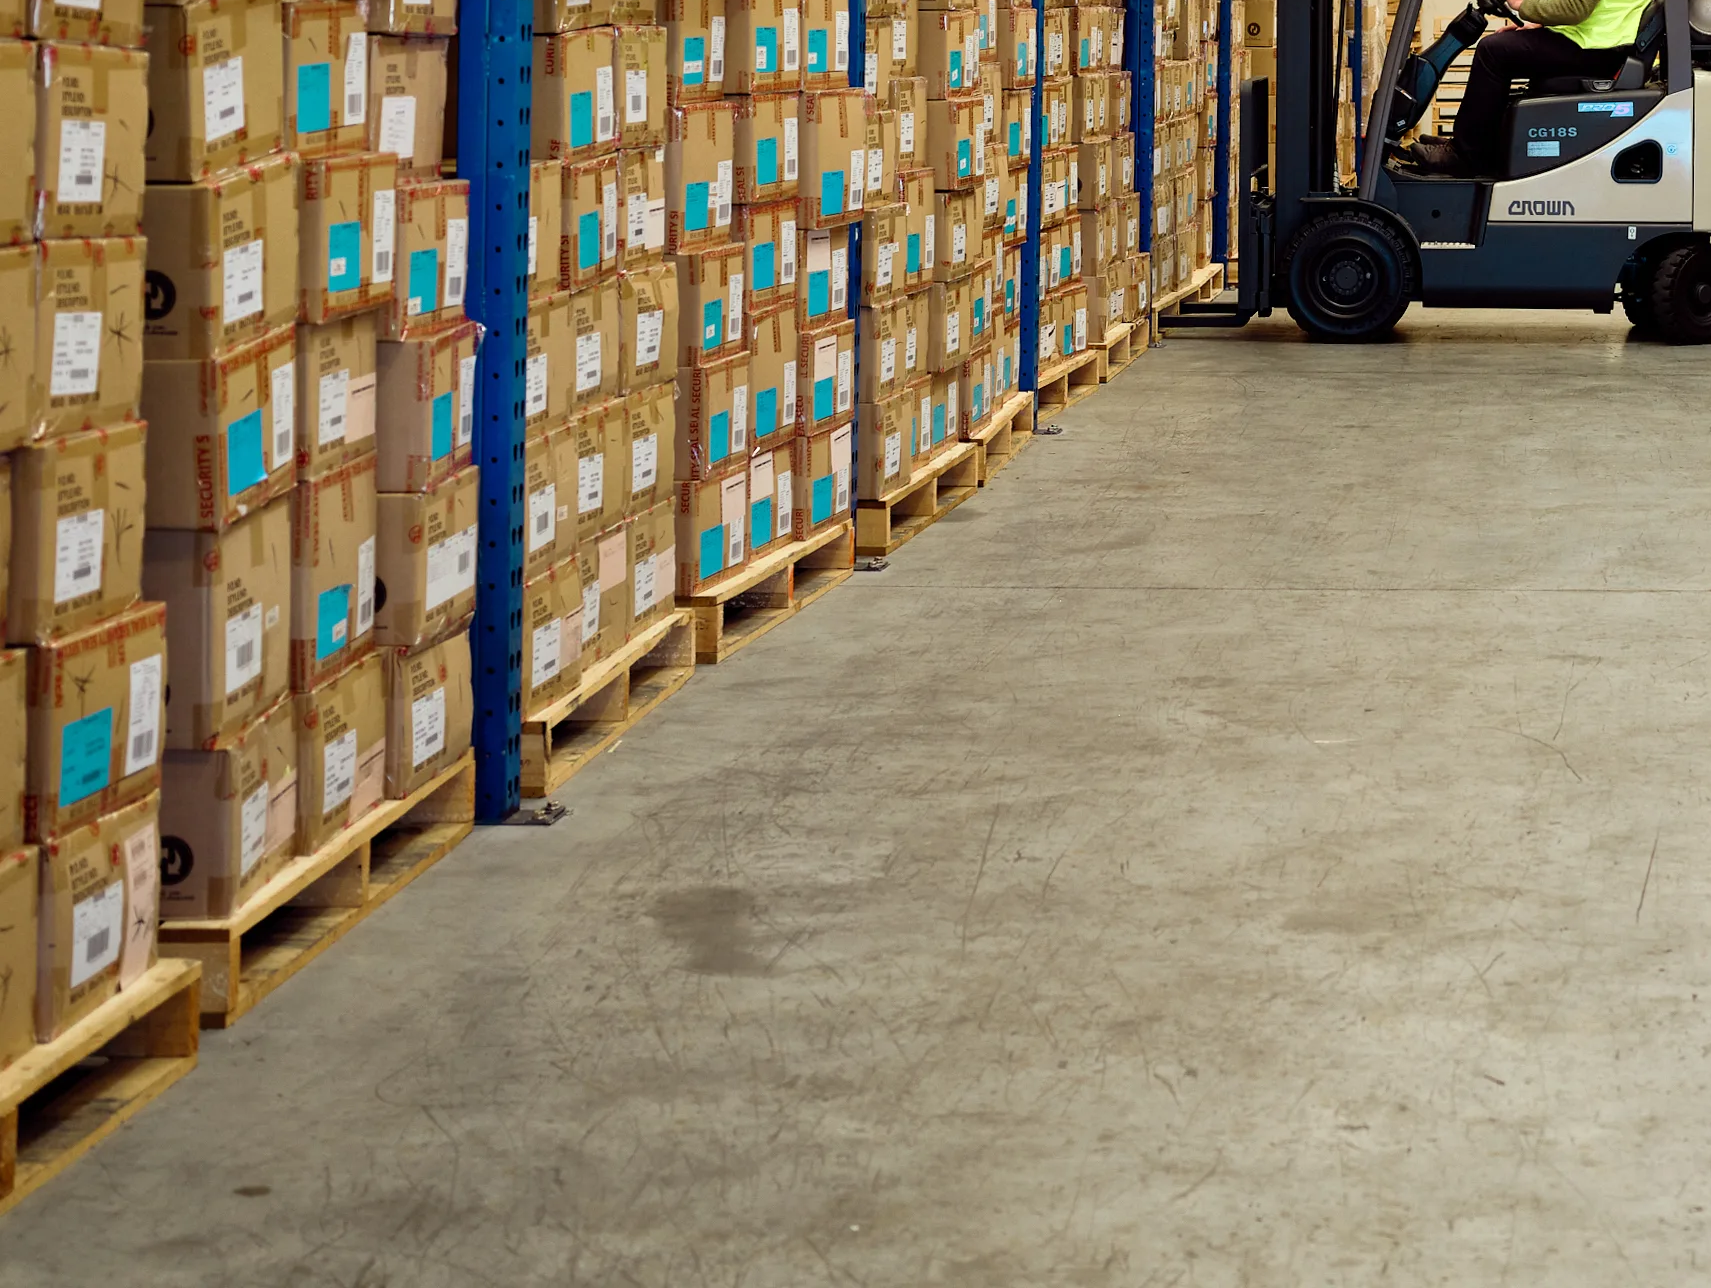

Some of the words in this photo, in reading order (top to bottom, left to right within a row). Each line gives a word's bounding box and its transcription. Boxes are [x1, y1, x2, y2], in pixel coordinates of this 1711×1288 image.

[806, 93, 815, 115] SEAL
[1528, 127, 1577, 138] CG18S
[1508, 200, 1575, 215] CROWN
[197, 448, 213, 519] SECURITY
